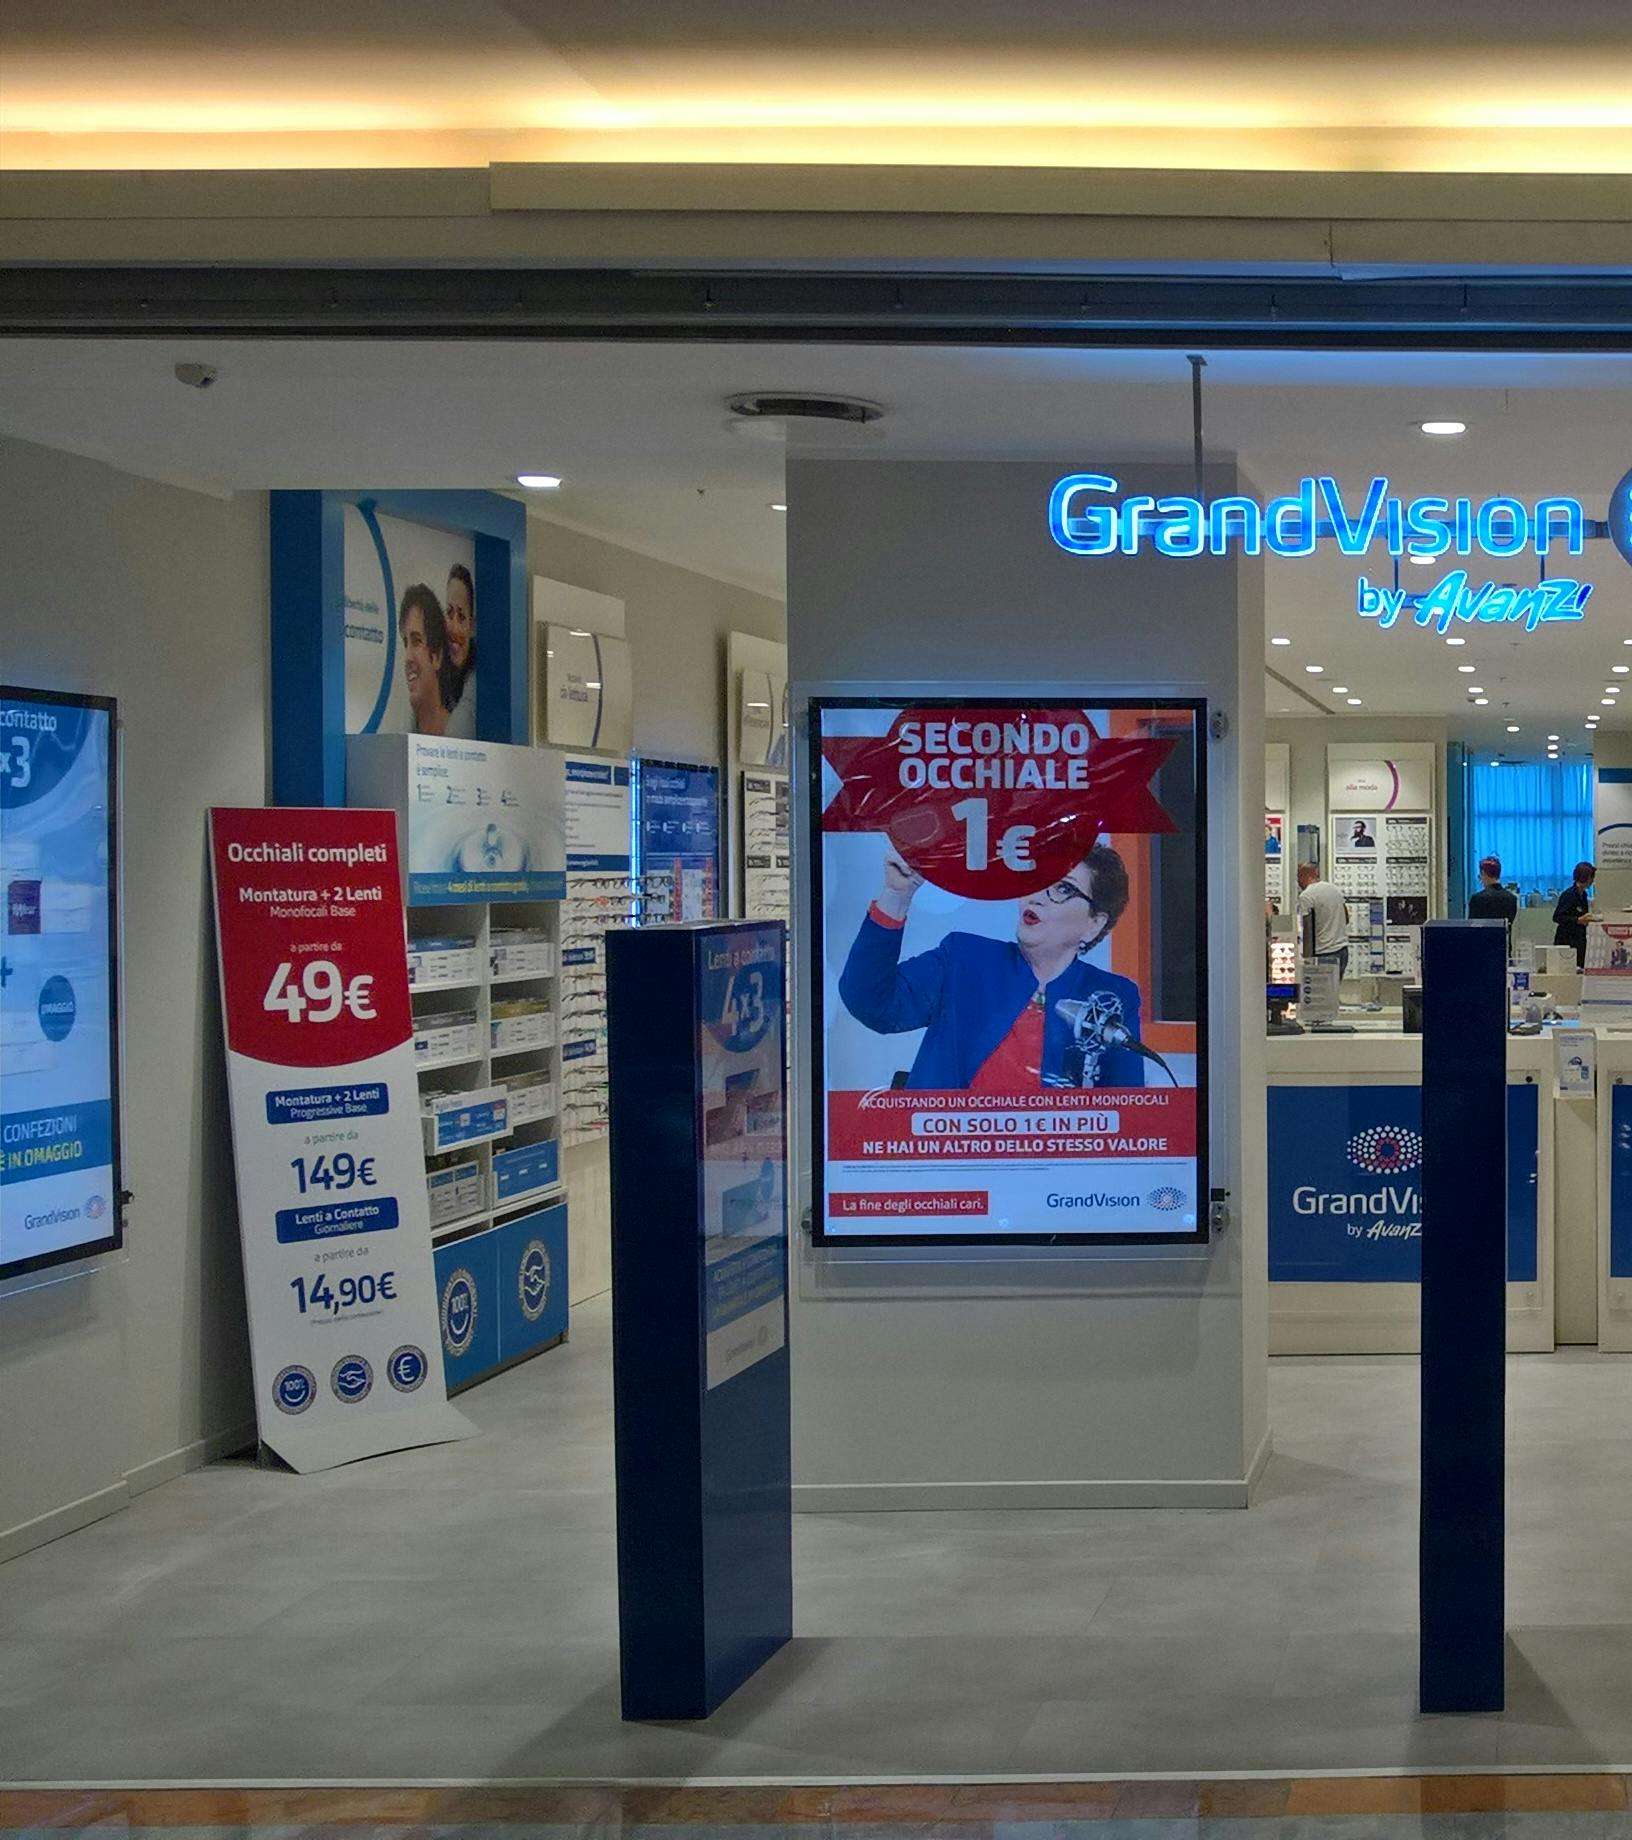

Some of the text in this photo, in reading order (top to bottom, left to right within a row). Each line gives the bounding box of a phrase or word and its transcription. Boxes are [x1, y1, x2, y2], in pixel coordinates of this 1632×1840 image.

[1048, 473, 1585, 557] GrandVision
[1358, 577, 1406, 629] by
[898, 721, 1090, 754] SECONDO
[899, 759, 1090, 789] OCCHIALE
[227, 843, 387, 867] Occhiali completi
[239, 887, 317, 903] Montatura
[334, 886, 344, 900] 2
[347, 885, 382, 900] Lenti
[270, 905, 356, 918] Monofocali Base
[290, 940, 343, 954] a partire da
[264, 960, 377, 1023] 49€
[722, 972, 763, 1036] 4x3
[275, 1093, 332, 1107] Montatura
[344, 1091, 351, 1100] 2
[353, 1088, 380, 1100] Lenti
[863, 1094, 1168, 1109] ACQUISTANDO UN OCCHIALE CON LENTI MONOFOCALI
[290, 1103, 367, 1119] Progressive Base
[4, 1115, 77, 1143] CONFEZIONI
[923, 1118, 961, 1133] CON
[967, 1118, 1016, 1133] SOLO
[1052, 1117, 1070, 1131] IN
[1077, 1112, 1108, 1132] PIÙ
[304, 1130, 358, 1146] a partire da
[863, 1137, 1167, 1154] NE HAI UN ALTRO DELLO STESSO VALORE
[9, 1151, 21, 1170] IN
[24, 1141, 82, 1167] OMAGGIO
[291, 1153, 377, 1193] 149€
[842, 1197, 984, 1214] La fine degli occhiali cari.
[1046, 1193, 1140, 1210] GrandVision
[25, 1207, 80, 1230] GrandVision
[296, 1206, 379, 1225] Lenti a Contatto
[1347, 1223, 1363, 1238] by
[322, 1249, 354, 1263] partire
[356, 1247, 368, 1257] da
[290, 1271, 397, 1315] 14,90€
